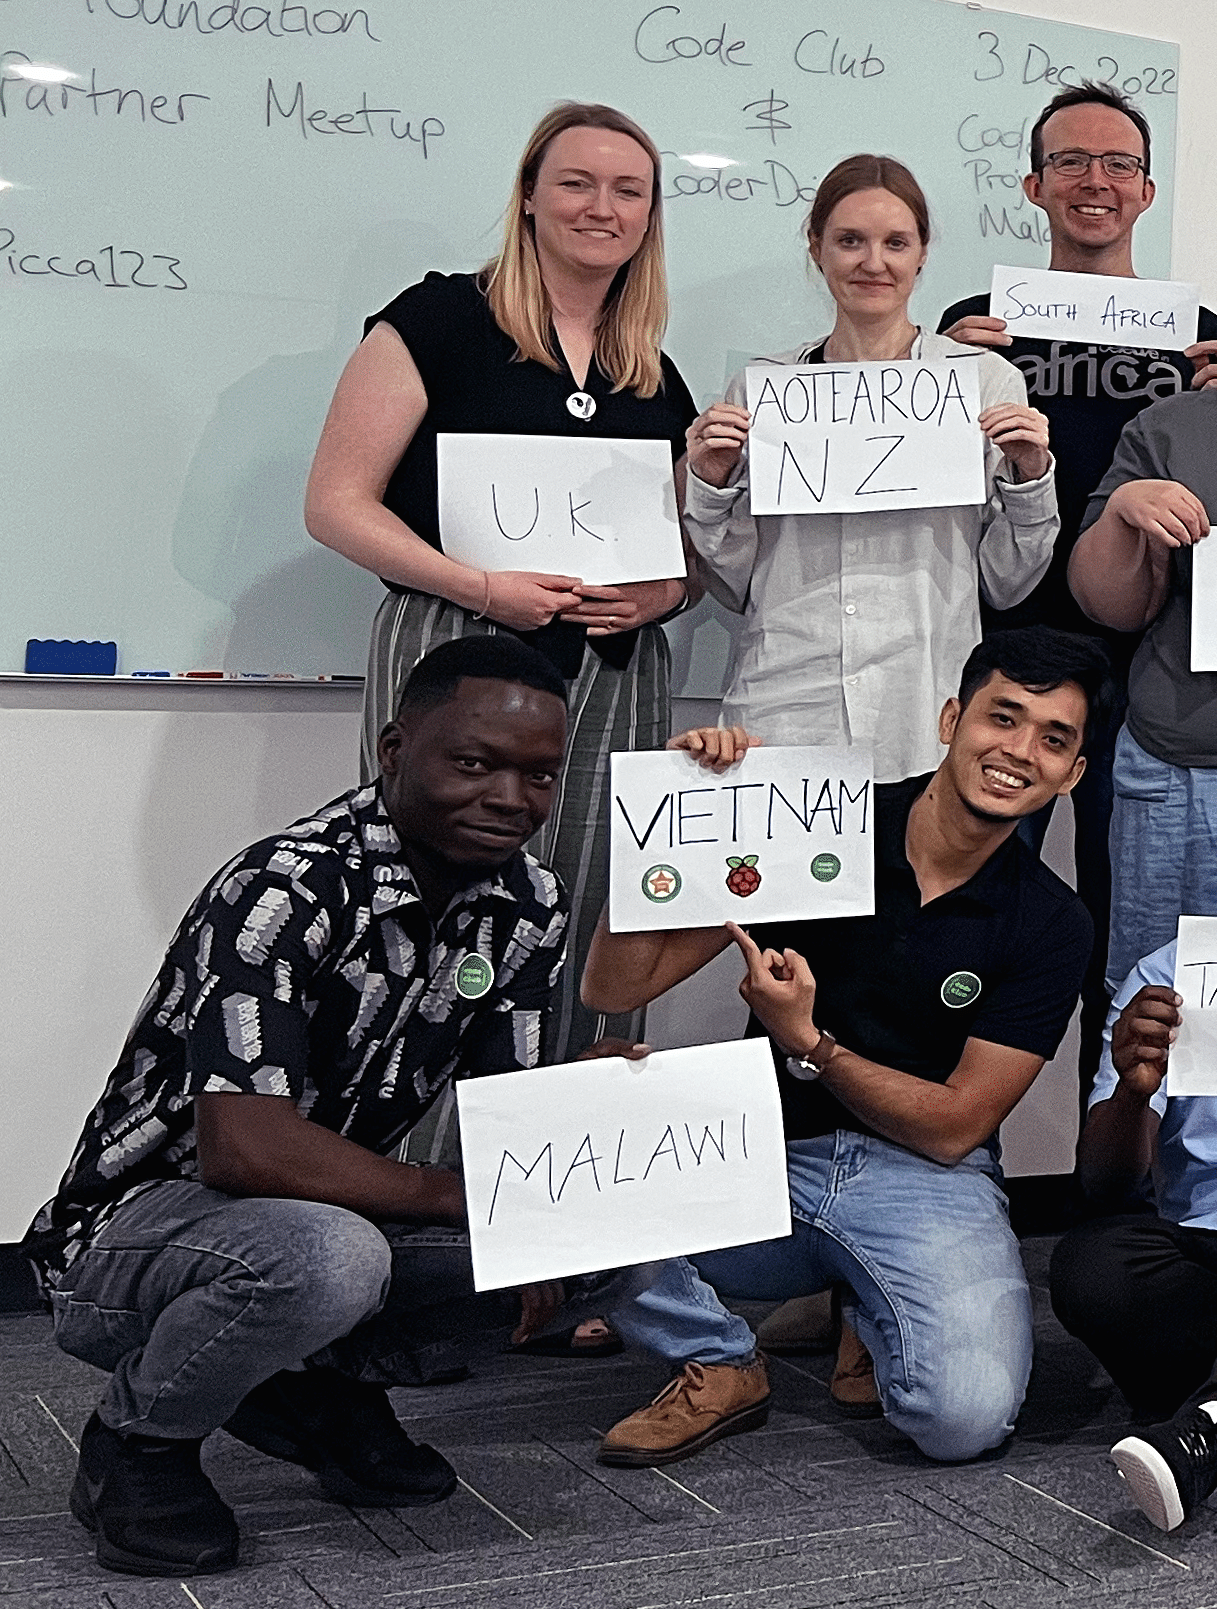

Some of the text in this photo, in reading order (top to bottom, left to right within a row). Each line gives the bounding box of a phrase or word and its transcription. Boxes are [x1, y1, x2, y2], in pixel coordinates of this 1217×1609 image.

[635, 6, 884, 78] Code Club
[974, 32, 1177, 96] 3 Dec 2022
[267, 78, 445, 159] Meetup
[957, 114, 1031, 160] Cod
[964, 158, 1025, 210] Proj
[1003, 282, 1176, 335] SOUTH AFRICA
[752, 367, 972, 426] AOTEAROA
[1011, 341, 1182, 400] africa
[616, 778, 870, 850] VIETNAM
[488, 1113, 748, 1226] MALAWI
